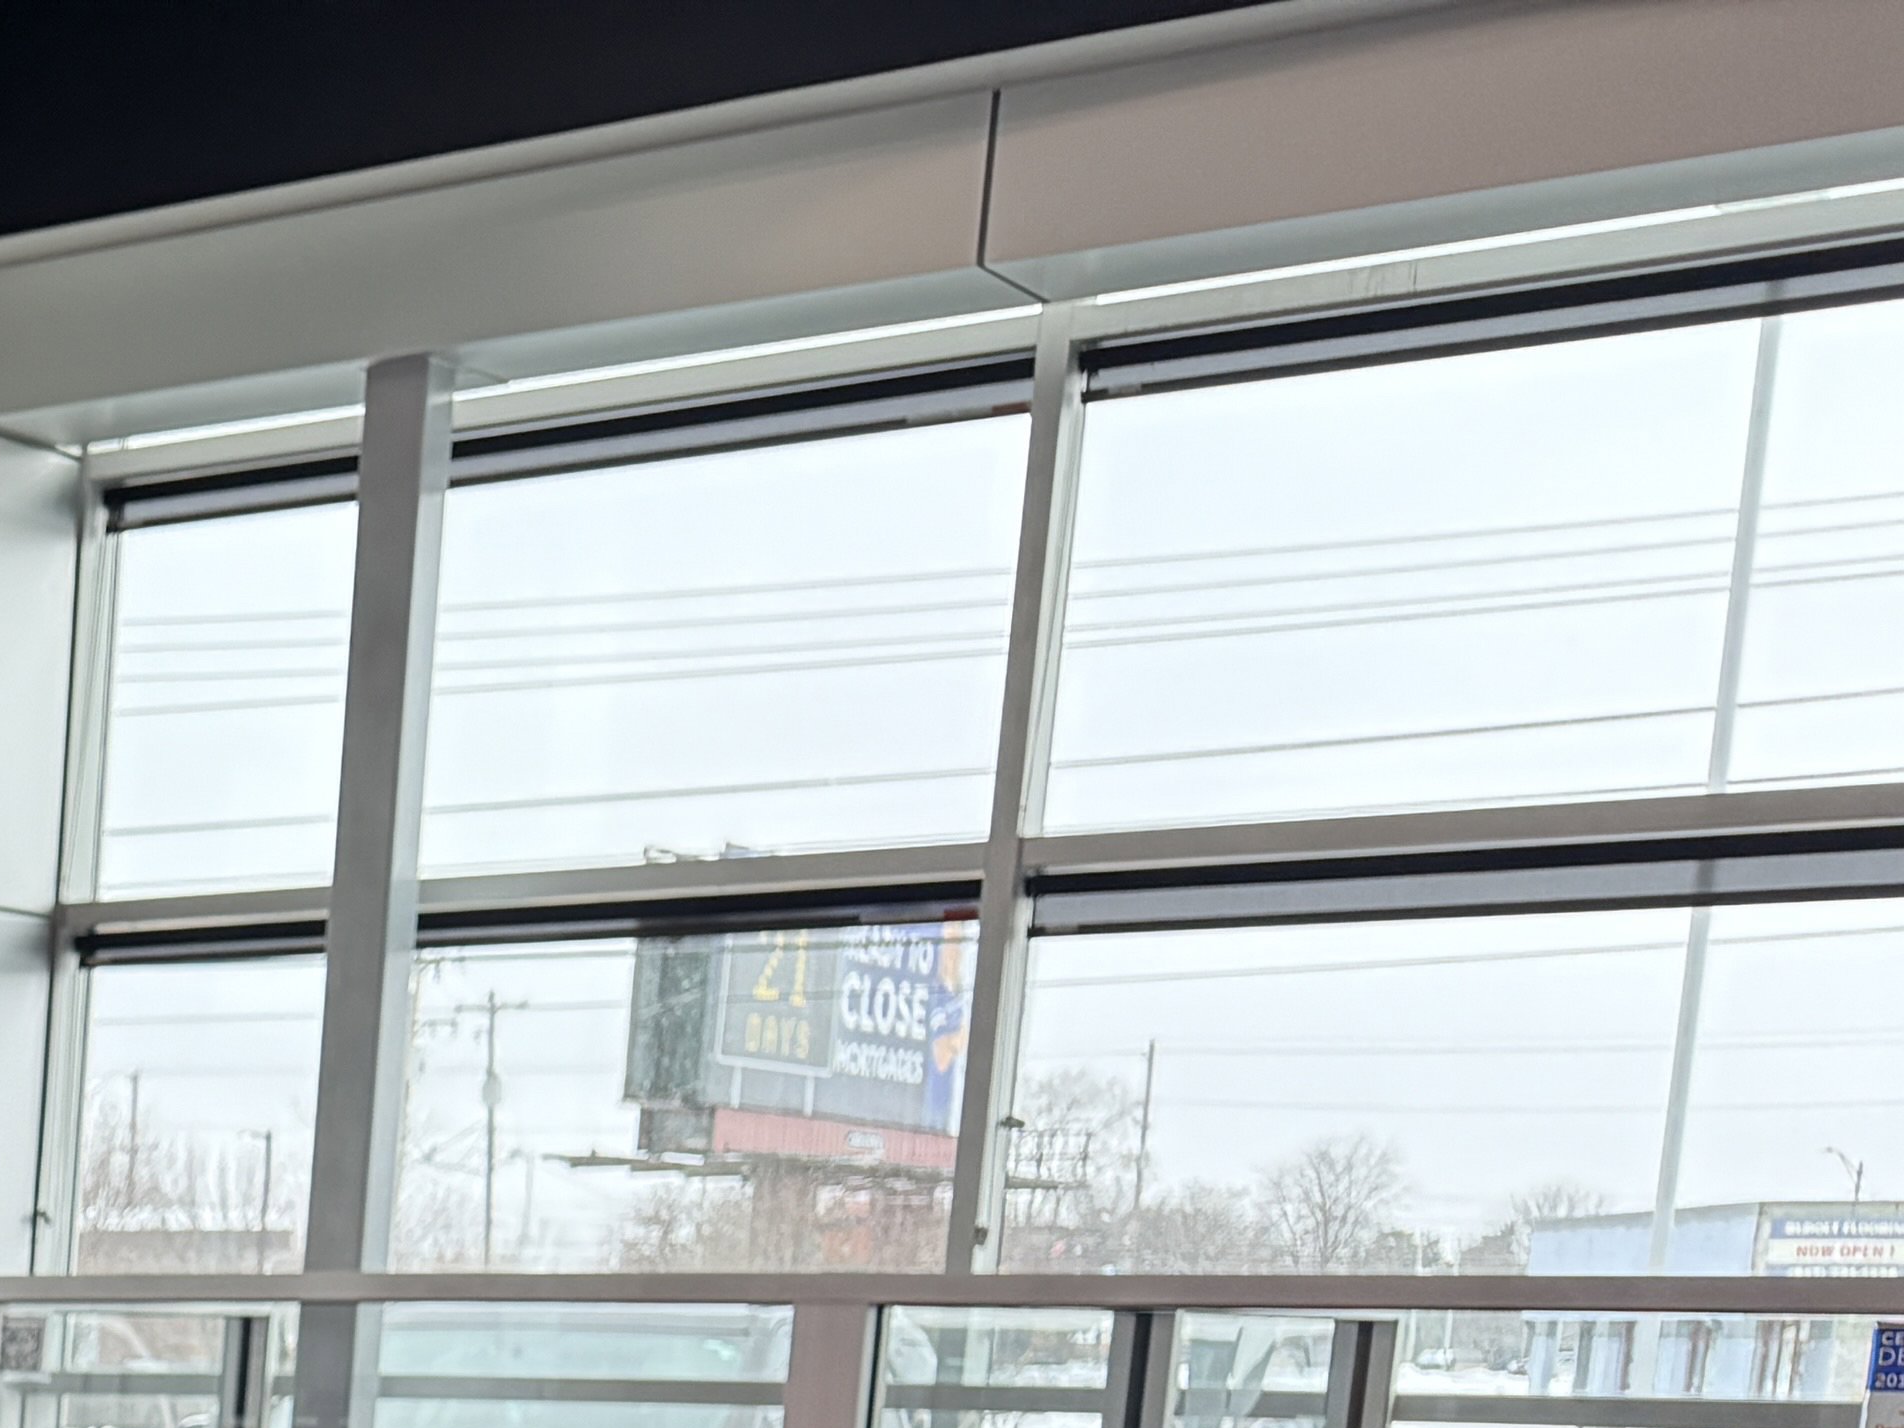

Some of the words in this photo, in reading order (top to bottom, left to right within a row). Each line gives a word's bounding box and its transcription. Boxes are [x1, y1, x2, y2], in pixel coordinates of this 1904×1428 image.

[841, 970, 929, 1041] CLOSE
[832, 1038, 924, 1085] MORTGAGES
[1796, 1245, 1835, 1258] NOW
[1839, 1245, 1884, 1258] OPEN
